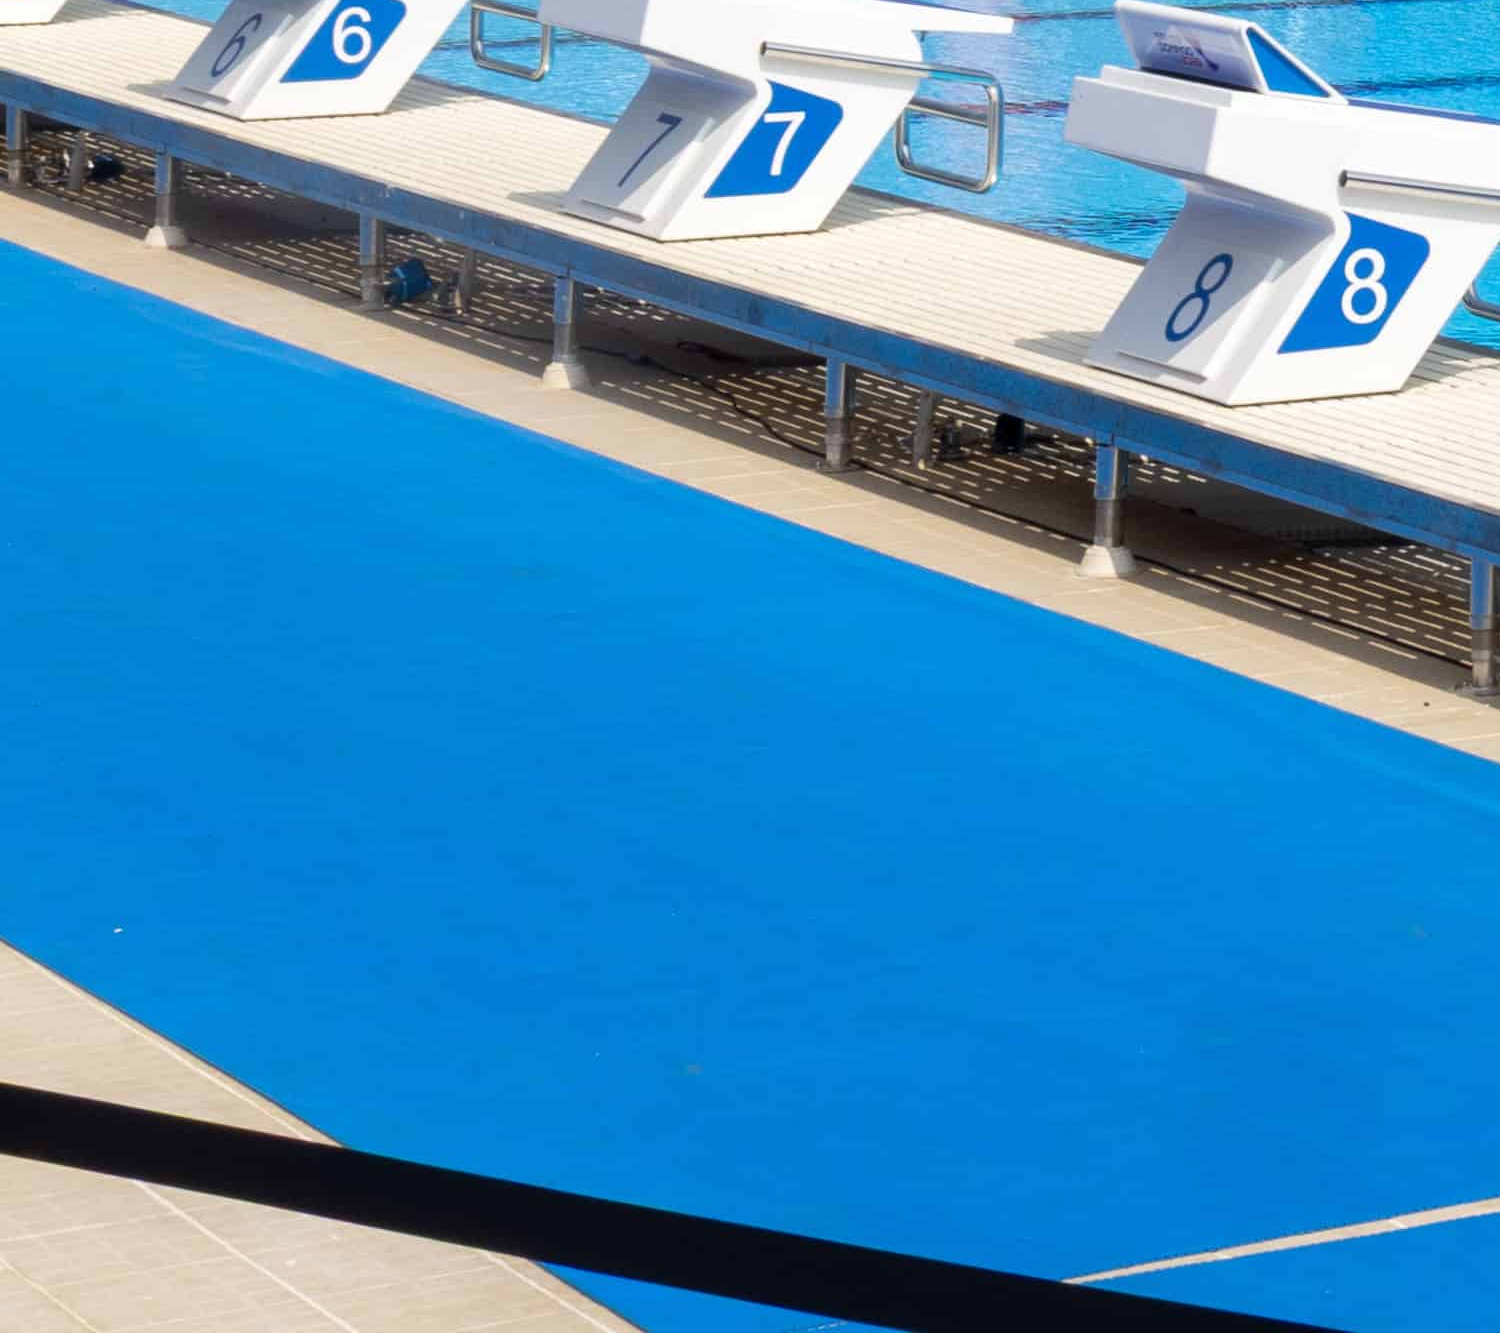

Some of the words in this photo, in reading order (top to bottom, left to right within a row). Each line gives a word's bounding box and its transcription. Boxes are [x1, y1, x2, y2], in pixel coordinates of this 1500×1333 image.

[210, 12, 263, 78] 6
[331, 6, 372, 64] 6
[617, 113, 683, 188] 7
[763, 110, 806, 177] 7
[1165, 253, 1233, 342] 8
[1341, 247, 1388, 324] 8
